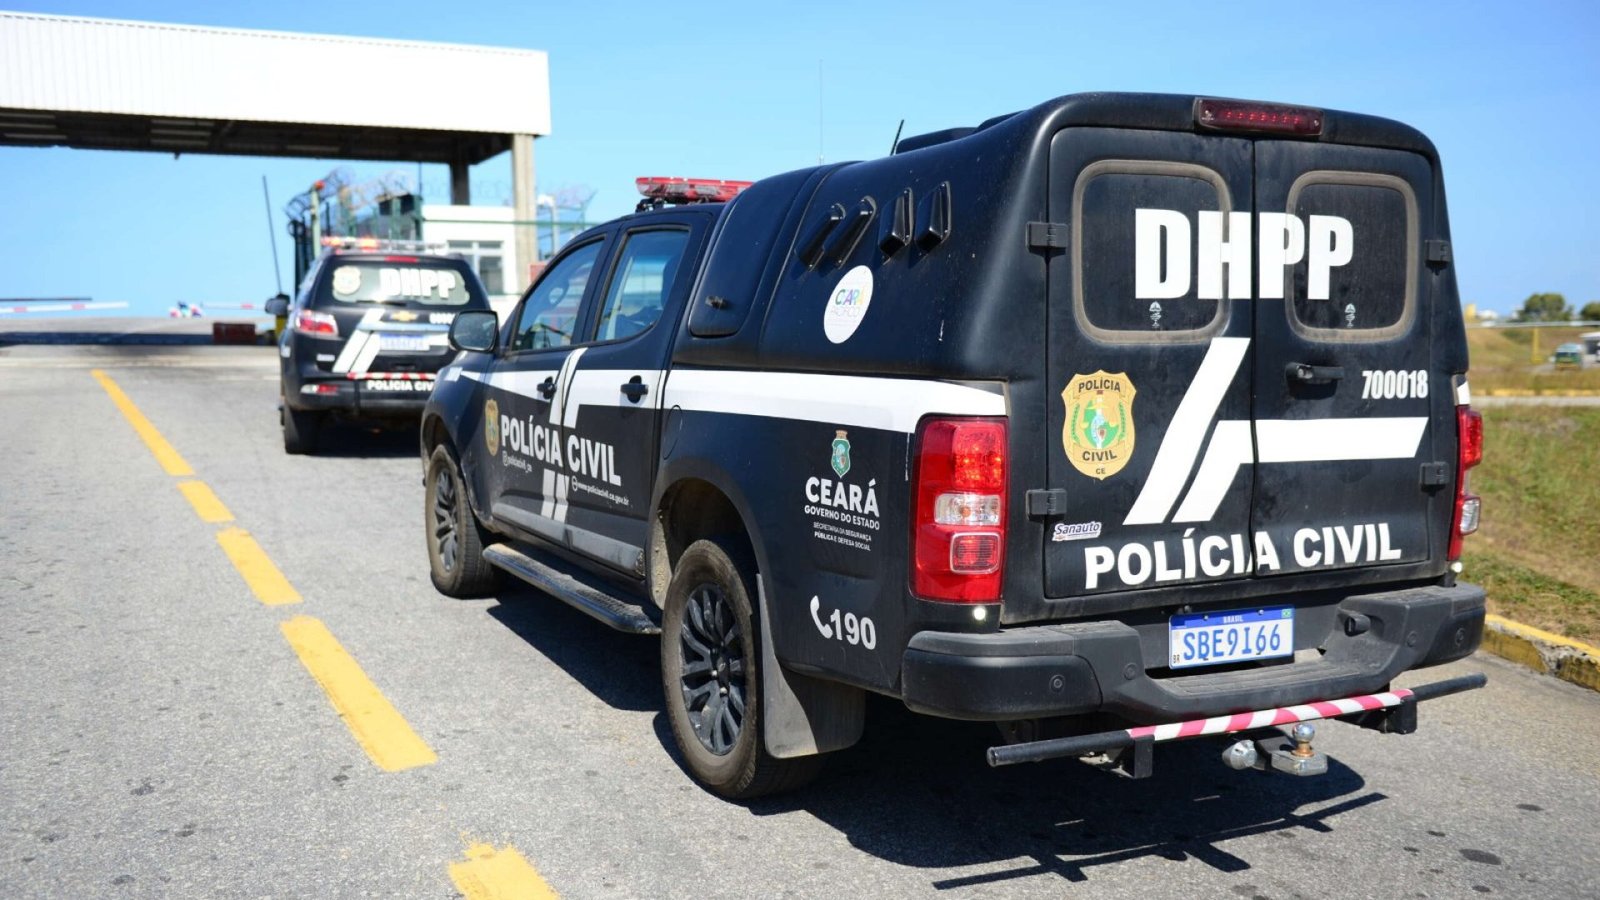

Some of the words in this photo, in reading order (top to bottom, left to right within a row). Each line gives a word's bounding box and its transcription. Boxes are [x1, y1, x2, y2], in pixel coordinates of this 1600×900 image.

[1135, 208, 1354, 300] DHPP
[379, 268, 456, 299] DHPP
[413, 380, 436, 392] CIV
[1078, 377, 1121, 393] POLÍCIA
[1361, 369, 1429, 399] 700018
[501, 414, 563, 468] POLÍCIA
[567, 434, 622, 487] CIVIL
[1082, 450, 1118, 462] CIVIL
[1095, 467, 1106, 475] CE
[805, 476, 880, 518] CEARÁ
[804, 505, 840, 520] GOVERNO
[840, 512, 852, 523] DO
[852, 515, 880, 530] ESTADO
[1055, 522, 1100, 534] Sanauto
[837, 536, 855, 546] DEFESA
[854, 541, 871, 551] SOCIAL
[1084, 528, 1281, 590] POLÍCIA
[1293, 522, 1402, 568] CIVIL
[830, 608, 876, 650] 190
[1223, 615, 1244, 624] BRASIL
[1183, 624, 1281, 661] SBE9I66
